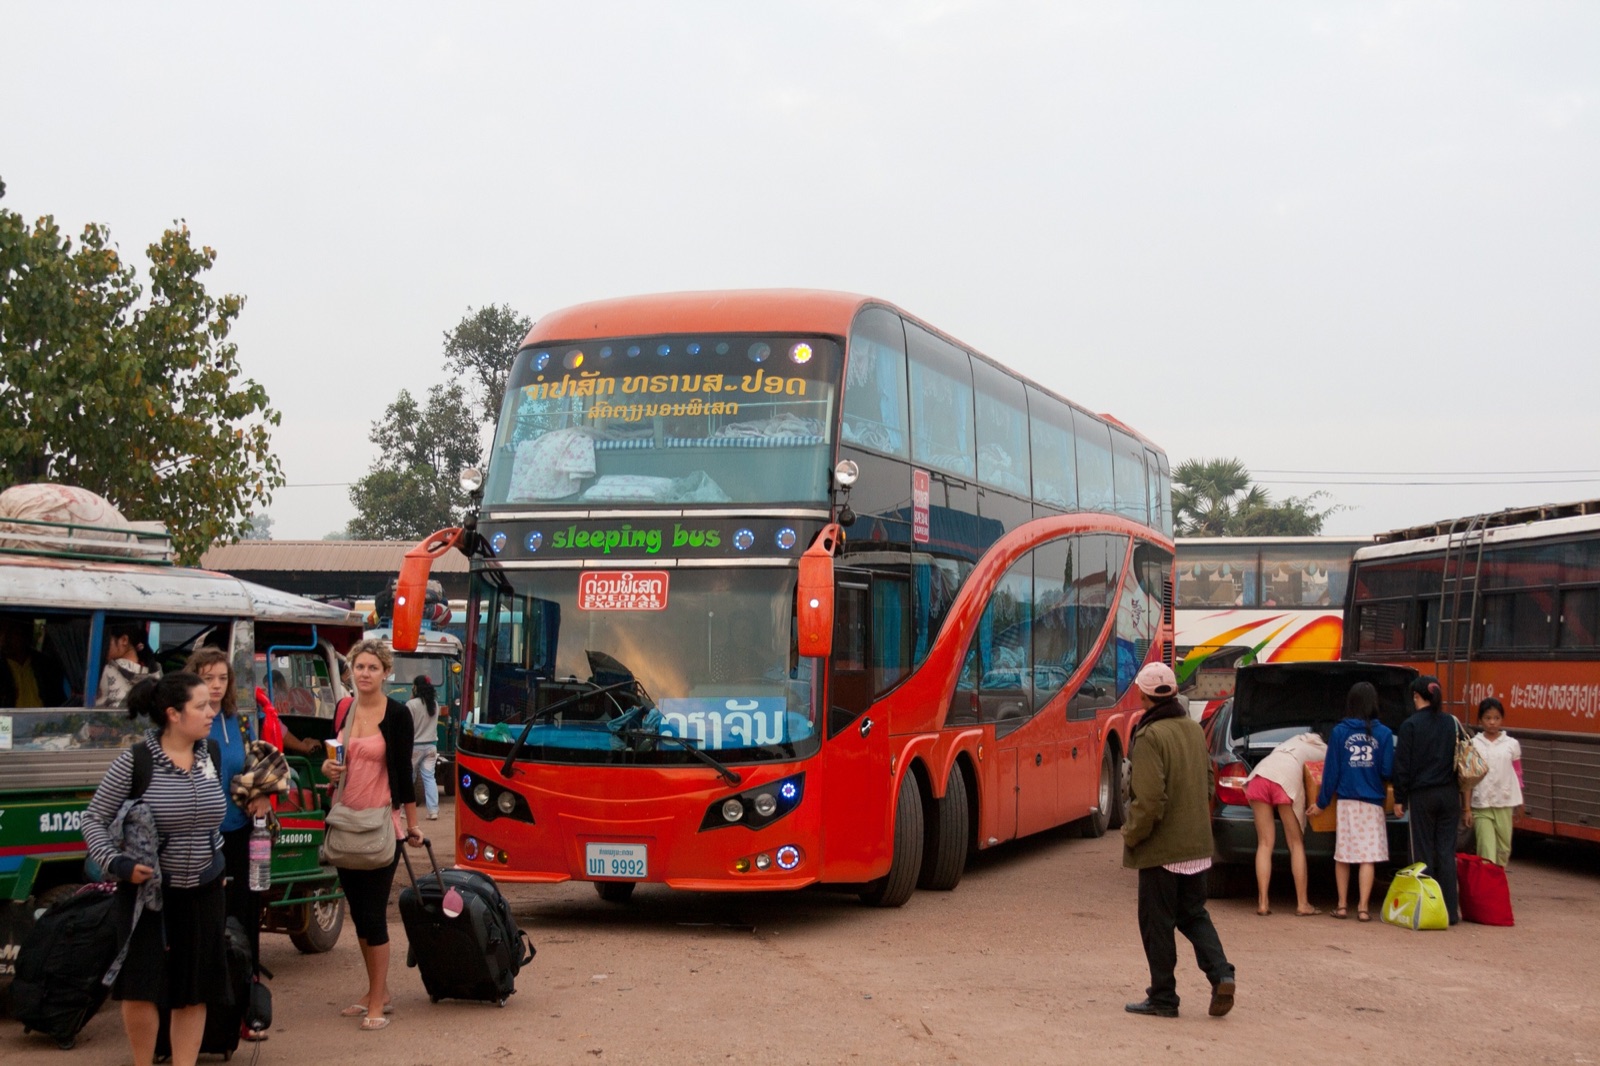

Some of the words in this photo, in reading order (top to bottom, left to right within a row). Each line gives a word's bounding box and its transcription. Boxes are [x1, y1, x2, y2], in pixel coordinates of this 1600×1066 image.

[551, 523, 662, 554] sleeping
[672, 523, 721, 548] bus
[585, 572, 662, 594] ດ່ວນພິເສດ
[584, 594, 660, 602] SPECIAL
[1349, 745, 1373, 761] 23
[611, 858, 644, 876] 9992
